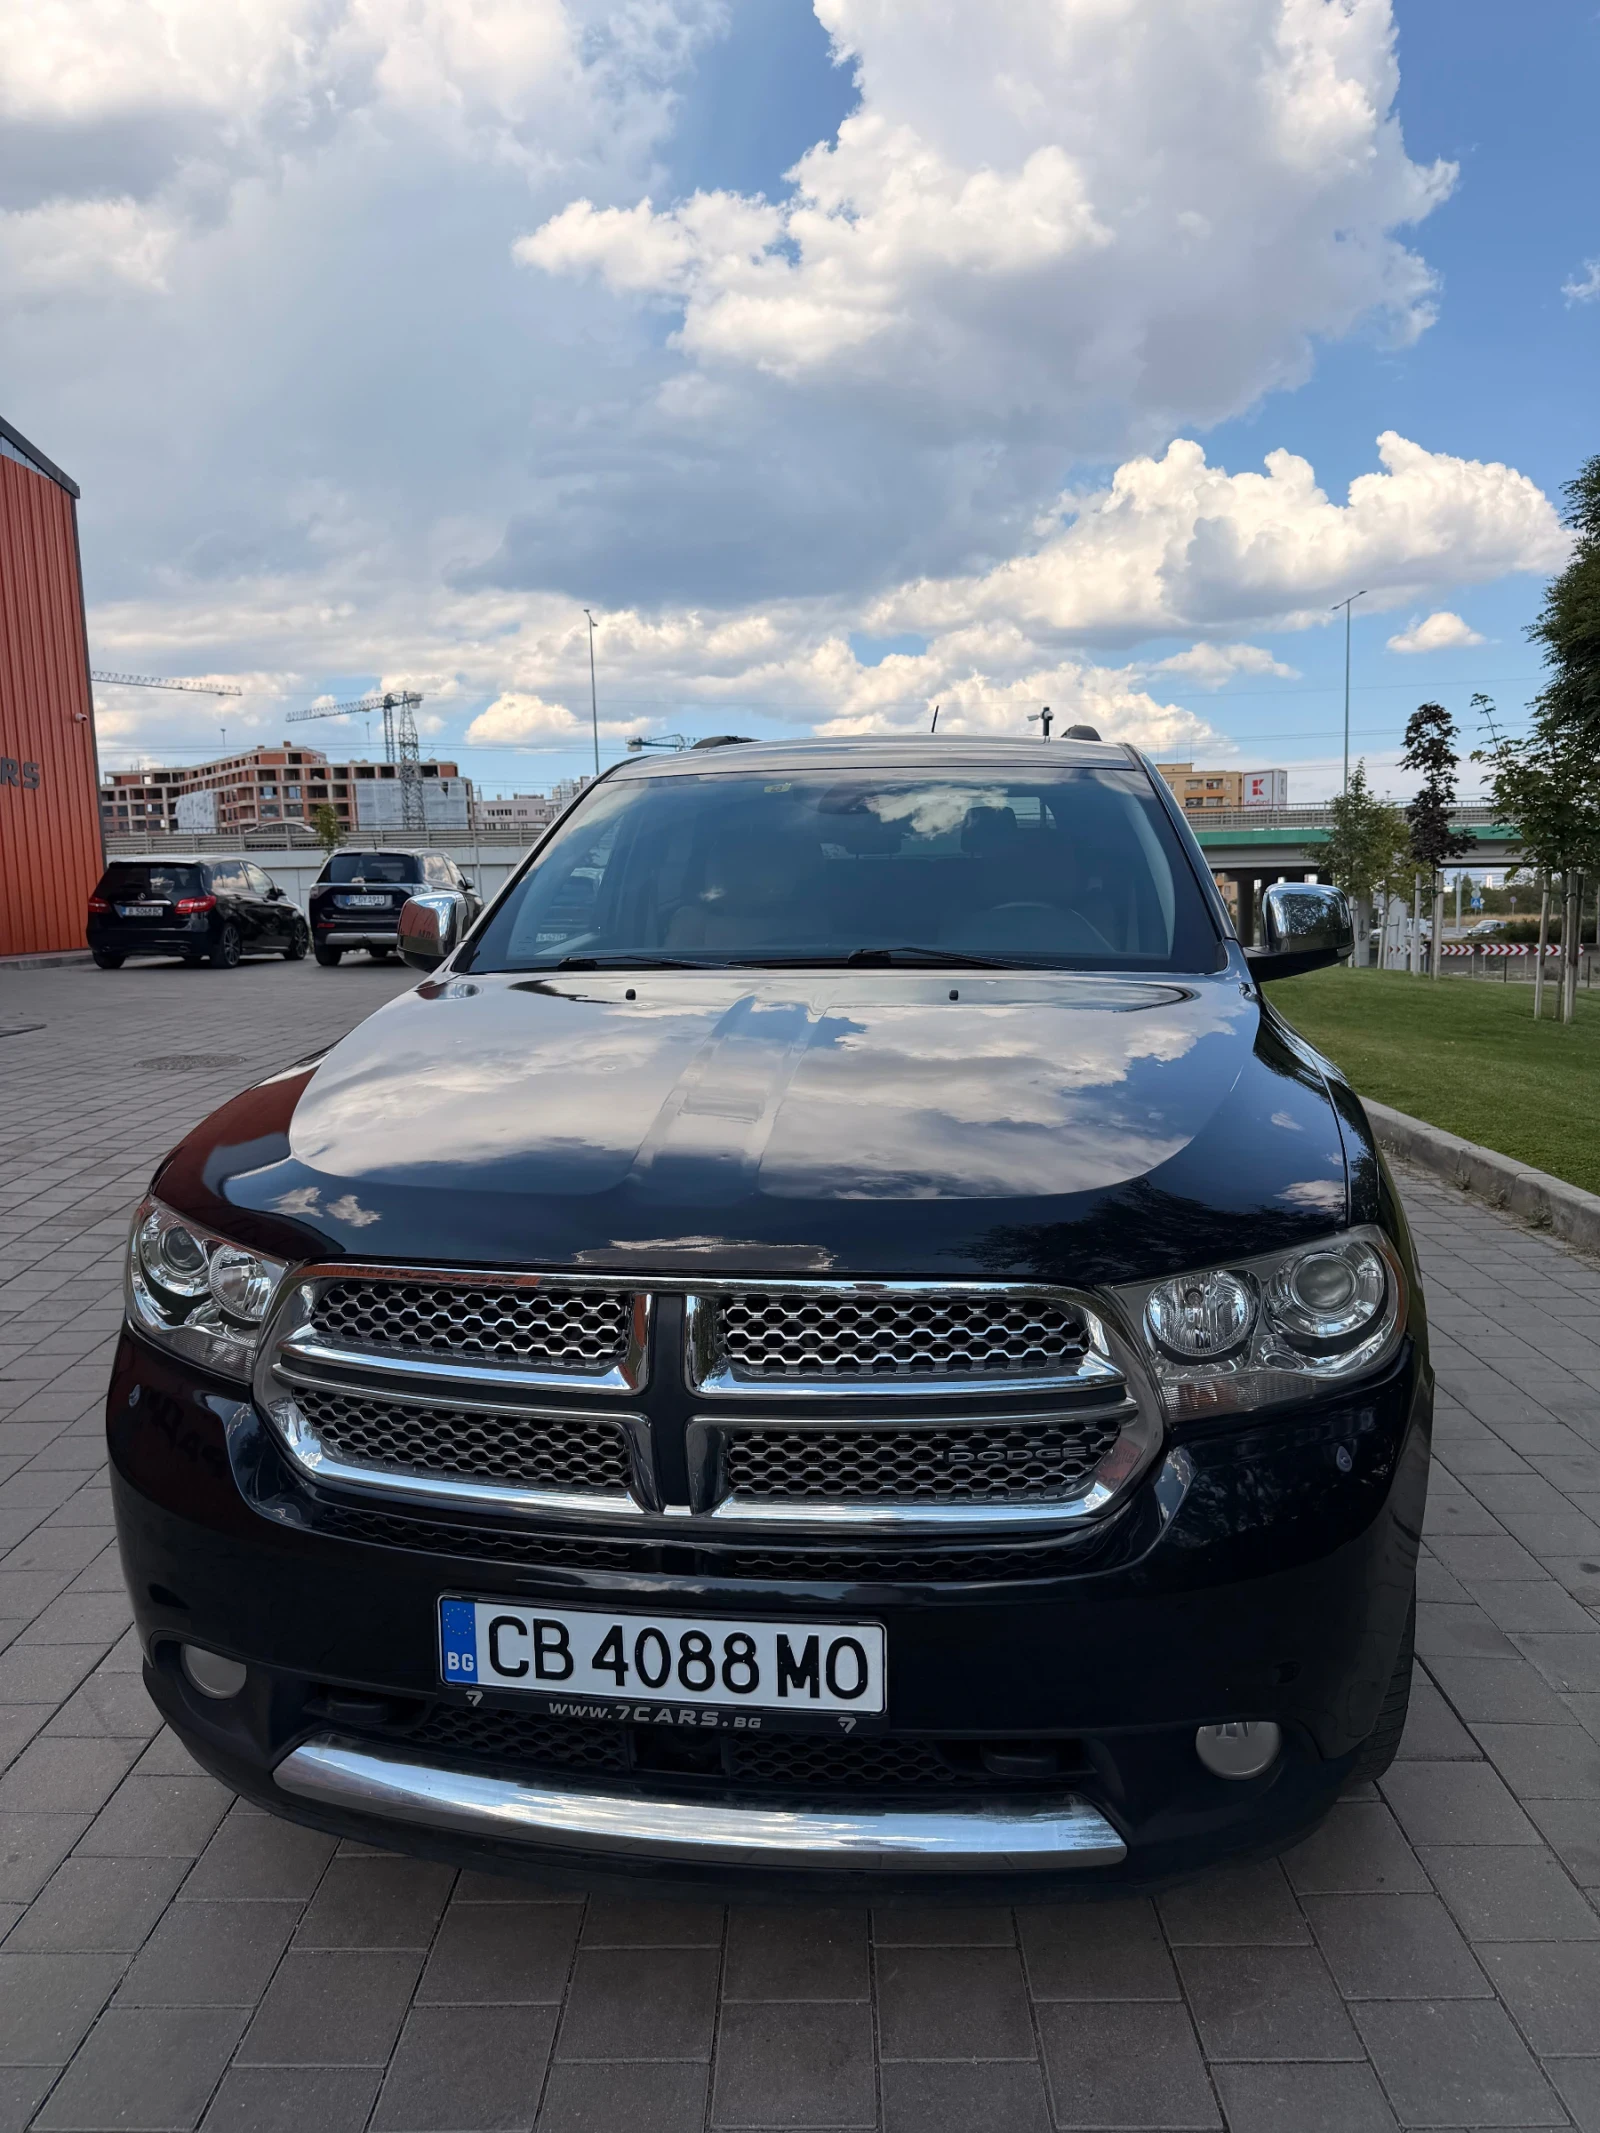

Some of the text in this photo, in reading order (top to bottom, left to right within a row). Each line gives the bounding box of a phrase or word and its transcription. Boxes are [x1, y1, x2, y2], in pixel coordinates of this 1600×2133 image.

[949, 1447, 1087, 1463] DODGE
[447, 1651, 475, 1672] BG
[488, 1615, 869, 1700] CB 4088 MO
